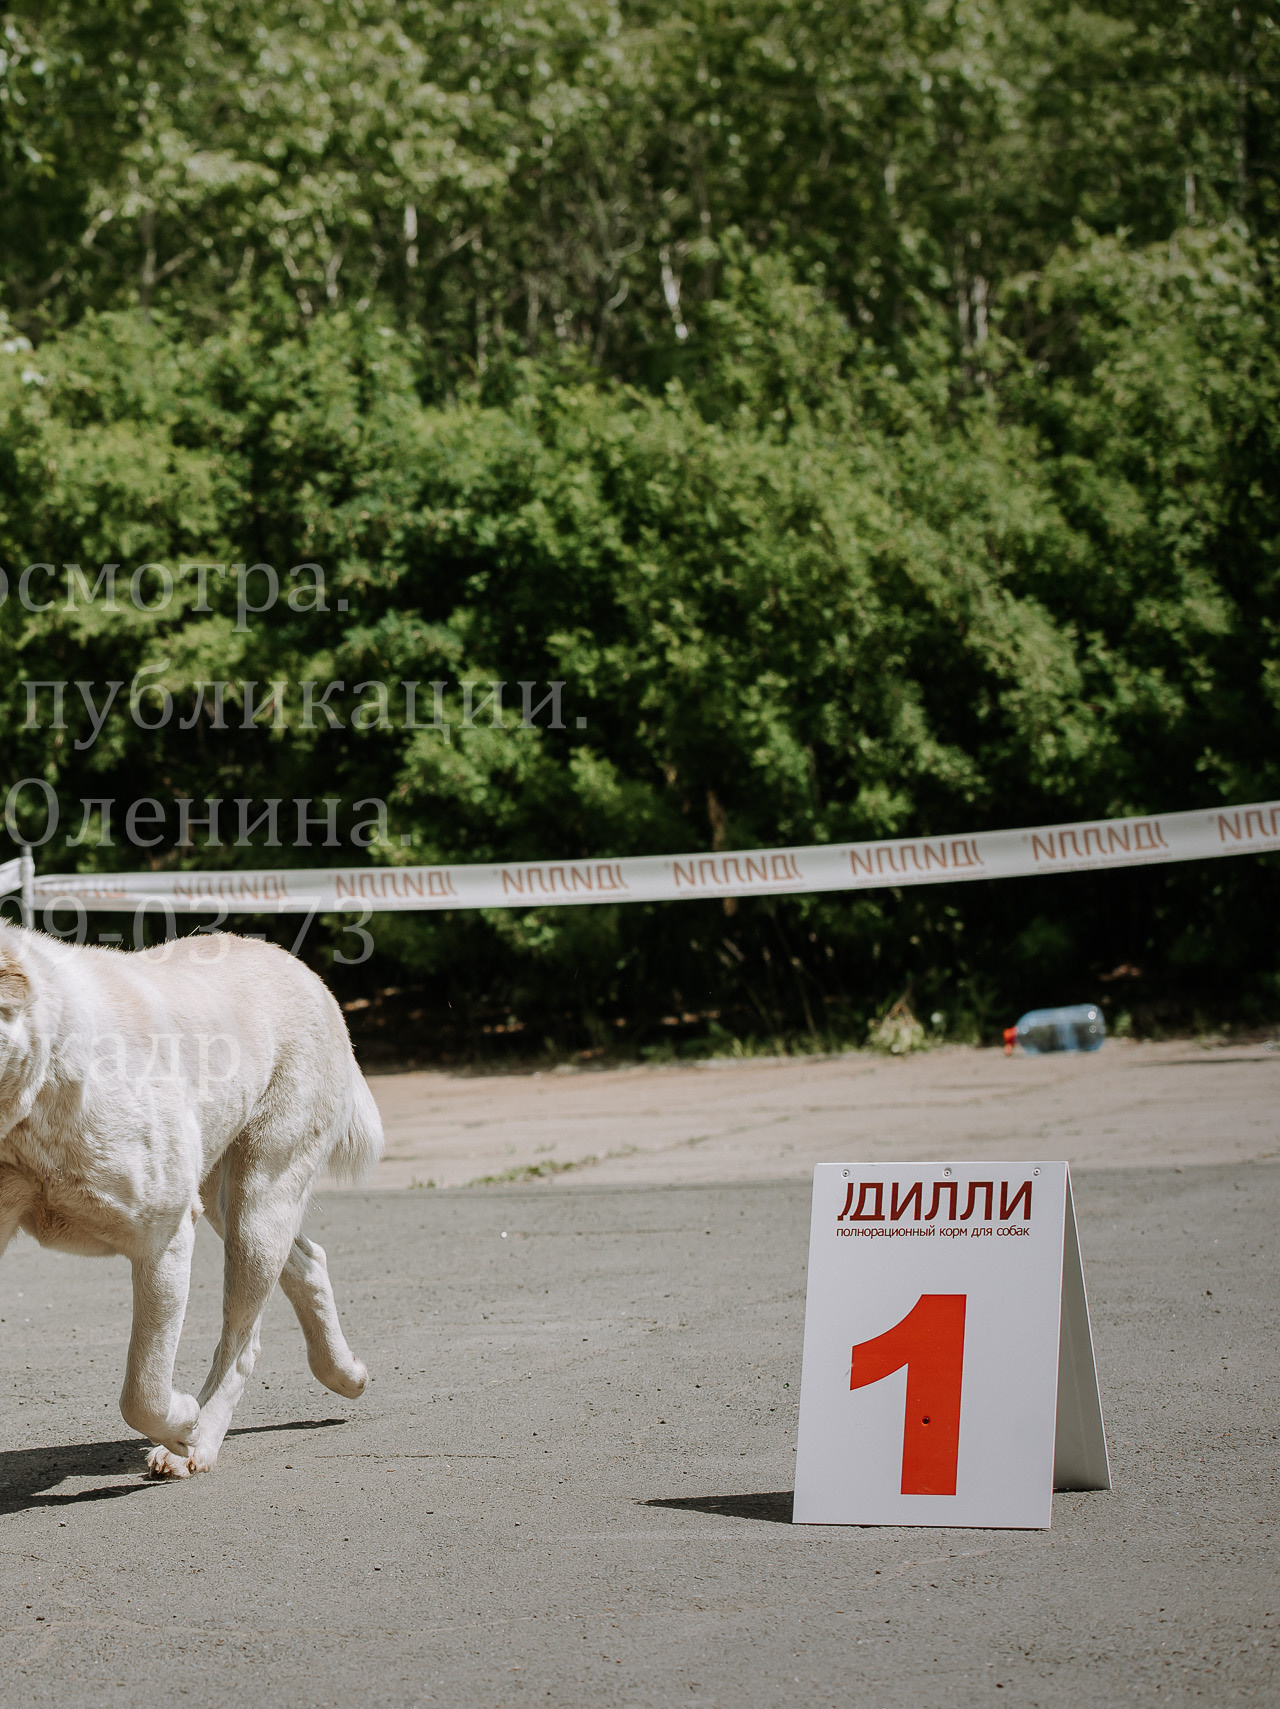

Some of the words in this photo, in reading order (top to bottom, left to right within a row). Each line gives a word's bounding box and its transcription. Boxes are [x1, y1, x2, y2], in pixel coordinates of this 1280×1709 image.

[836, 1225, 935, 1239] полнорационный
[939, 1227, 968, 1239] корм
[971, 1226, 993, 1238] для
[997, 1224, 1031, 1237] собак
[850, 1294, 967, 1496] 1
